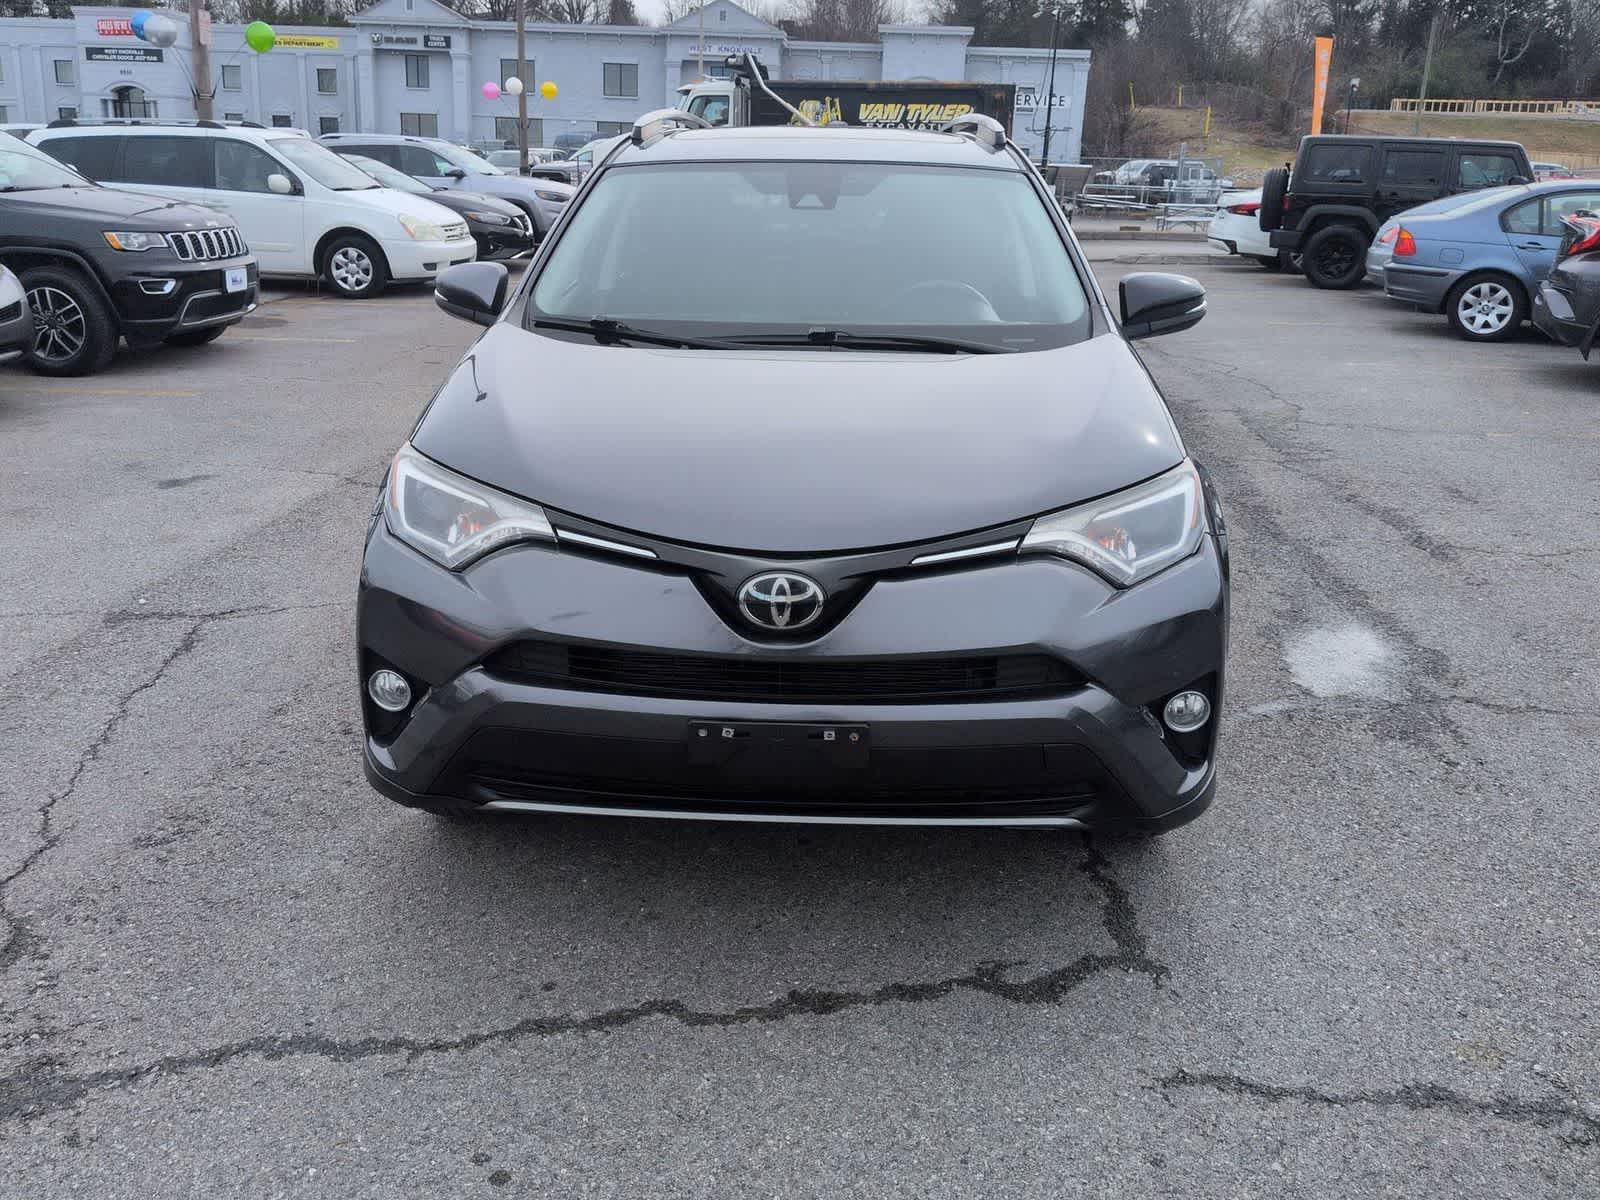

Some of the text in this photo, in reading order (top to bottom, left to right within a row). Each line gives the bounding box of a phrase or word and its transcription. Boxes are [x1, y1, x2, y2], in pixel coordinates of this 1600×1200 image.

[1016, 94, 1065, 107] ERVICE
[859, 103, 975, 123] VAN TYLER
